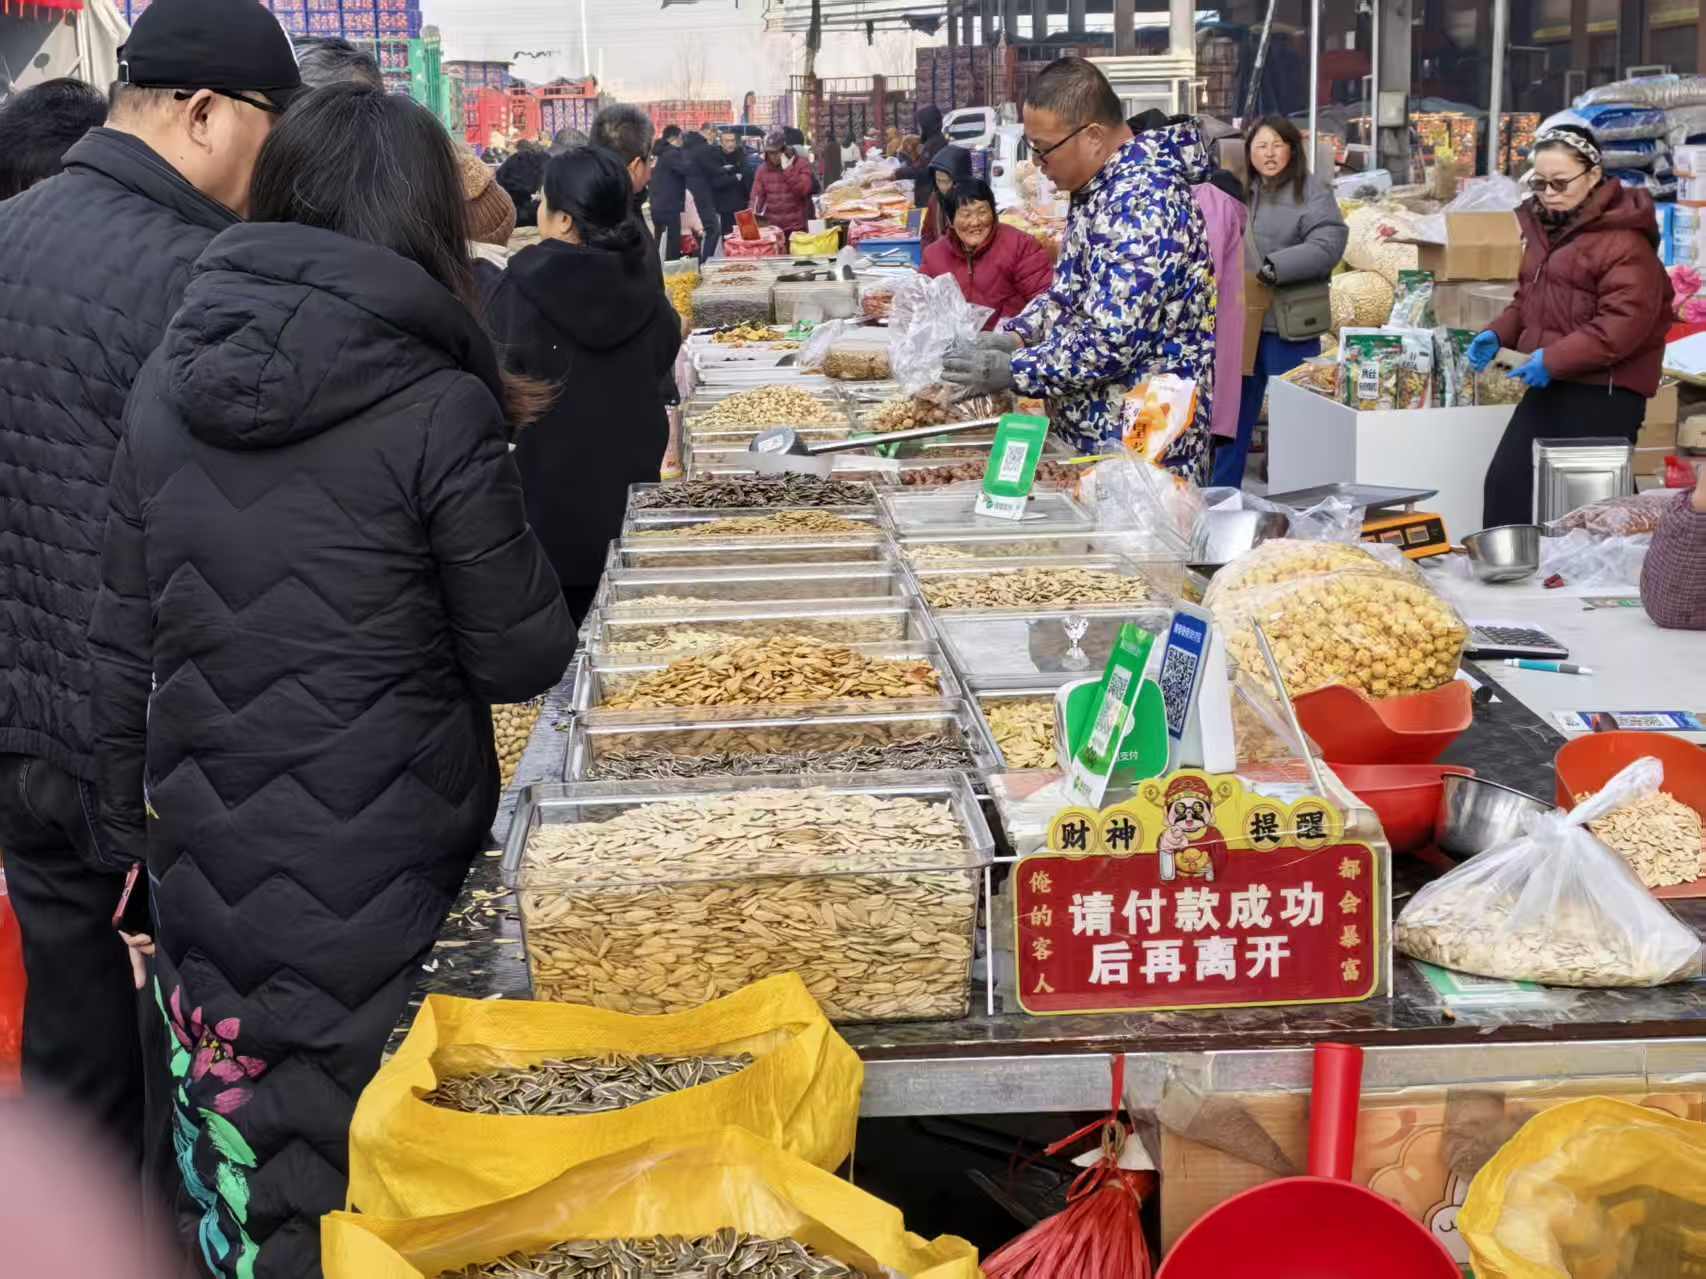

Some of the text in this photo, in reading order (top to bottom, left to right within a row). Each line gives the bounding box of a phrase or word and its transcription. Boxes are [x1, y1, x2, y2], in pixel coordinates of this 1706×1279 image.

[1061, 809, 1329, 851] 财神 提醒
[1028, 871, 1055, 995] 俺的客人
[1068, 881, 1325, 937] 请付款成功
[1338, 856, 1362, 983] 都会暴富
[1088, 935, 1292, 985] 后再离开
